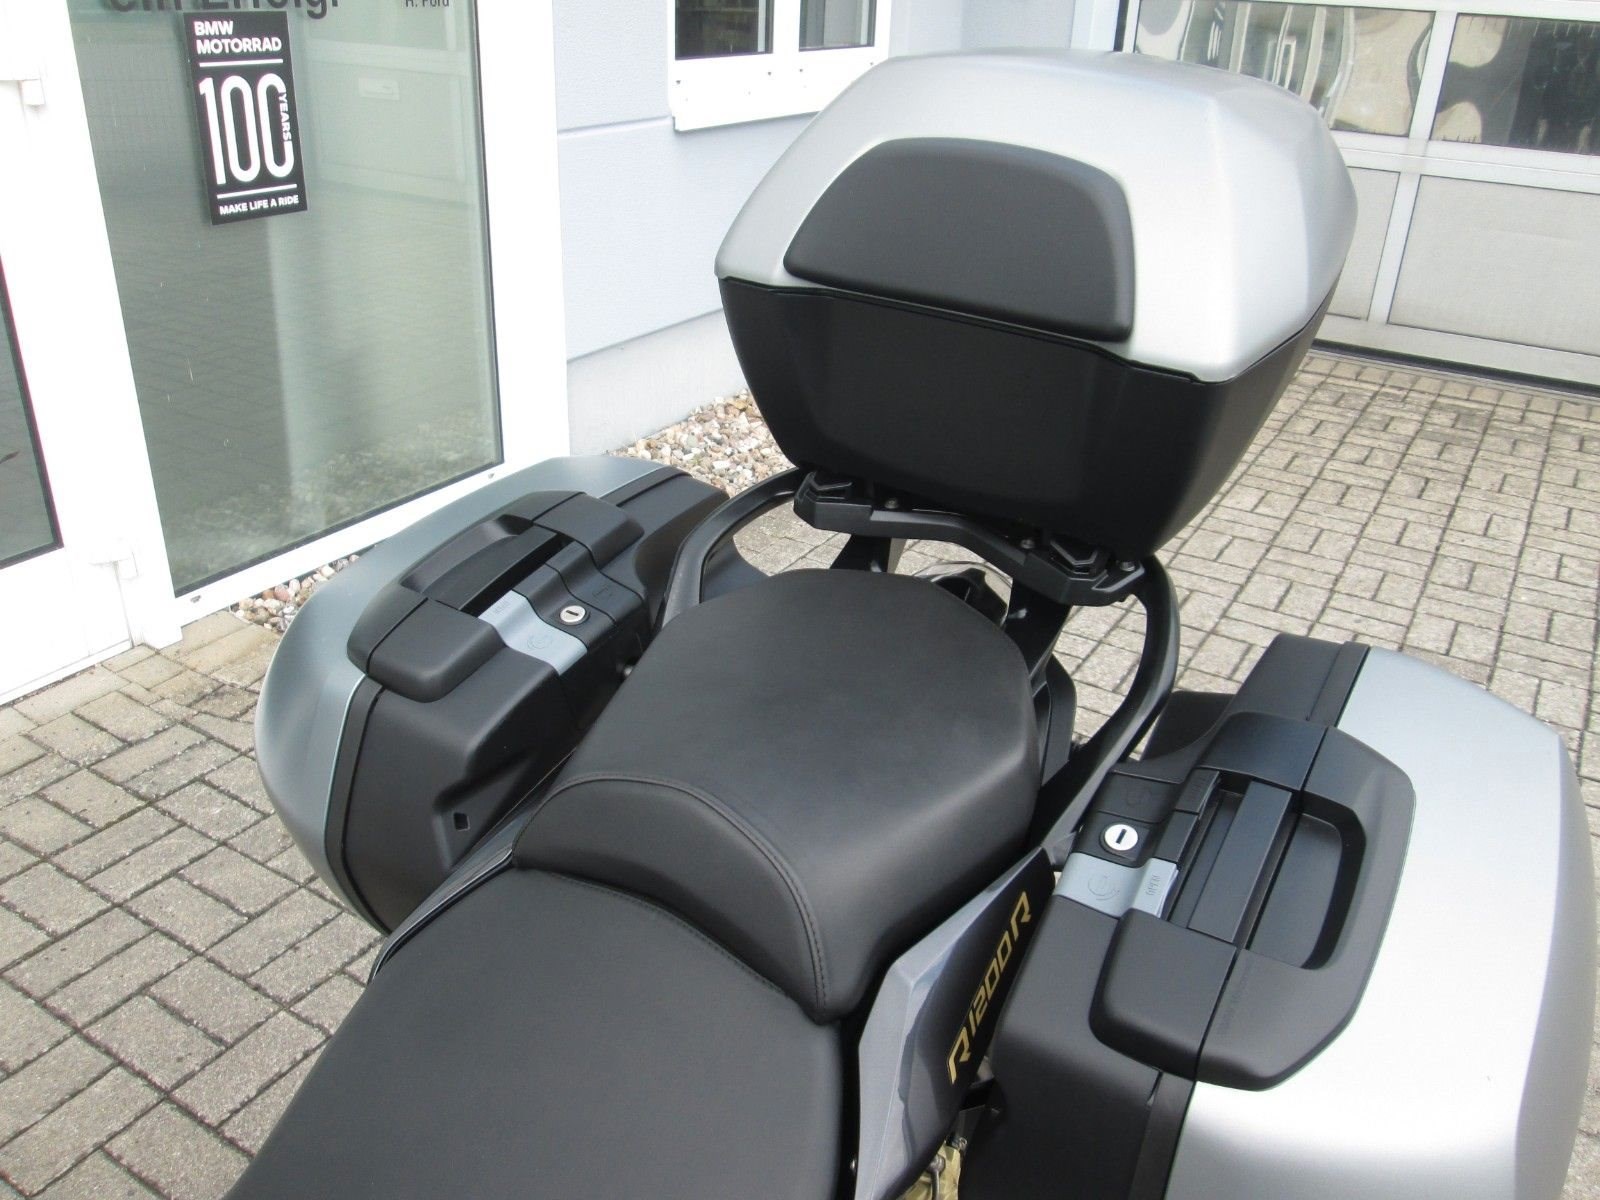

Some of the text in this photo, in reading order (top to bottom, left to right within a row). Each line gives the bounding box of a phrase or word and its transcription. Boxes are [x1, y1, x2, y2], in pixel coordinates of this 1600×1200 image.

[194, 21, 233, 36] BMW
[196, 37, 282, 54] MOTORRAD
[278, 92, 292, 141] YEARS
[199, 73, 295, 185] 100
[219, 195, 299, 215] MAKE LIFE A RIDE
